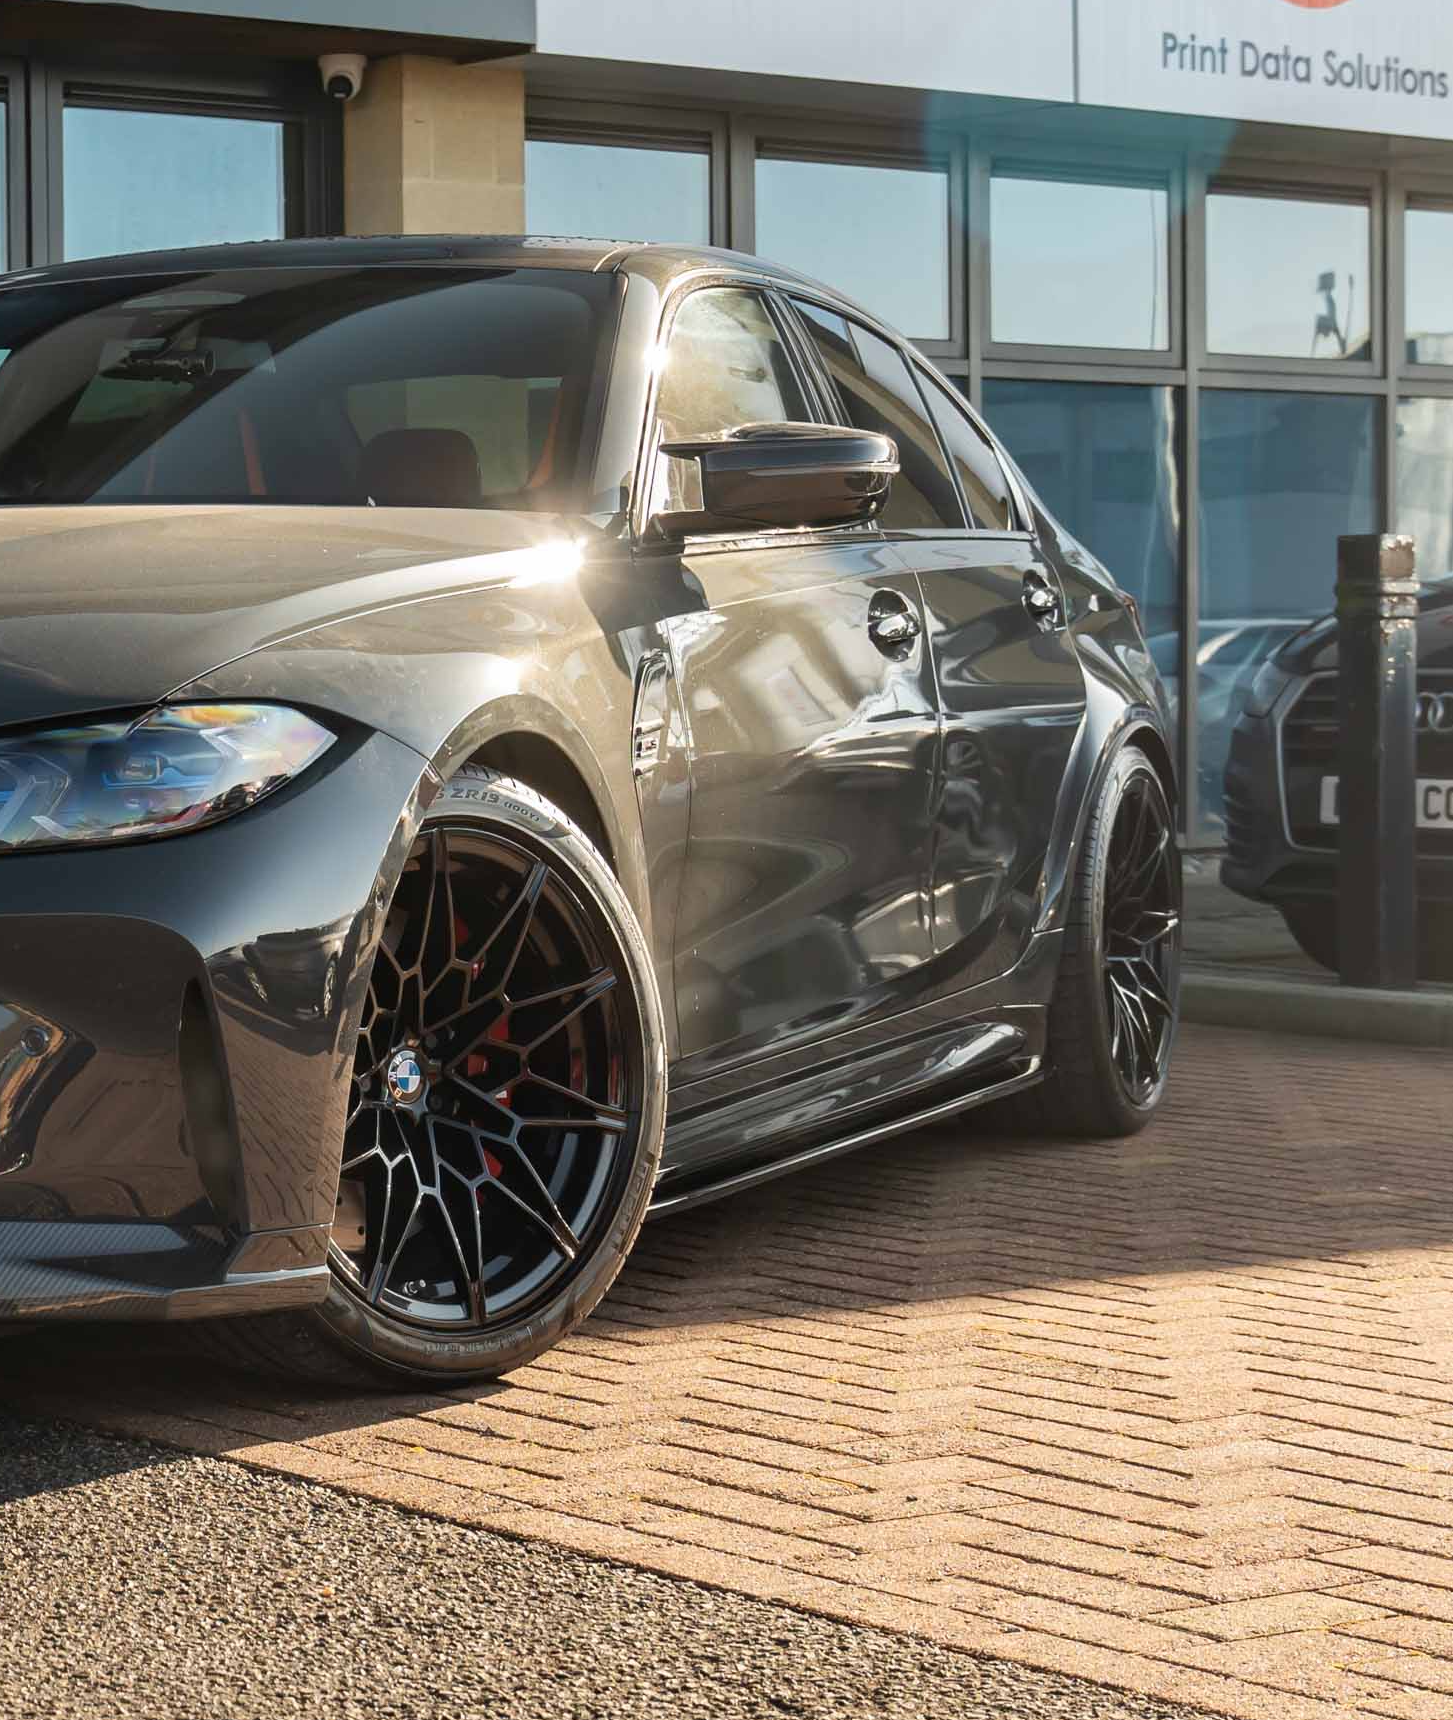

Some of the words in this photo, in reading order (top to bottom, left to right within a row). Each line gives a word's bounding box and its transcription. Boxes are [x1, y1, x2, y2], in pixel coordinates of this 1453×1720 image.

[1161, 32, 1228, 75] Print
[1240, 41, 1311, 84] Data
[1323, 50, 1448, 99] Solutions
